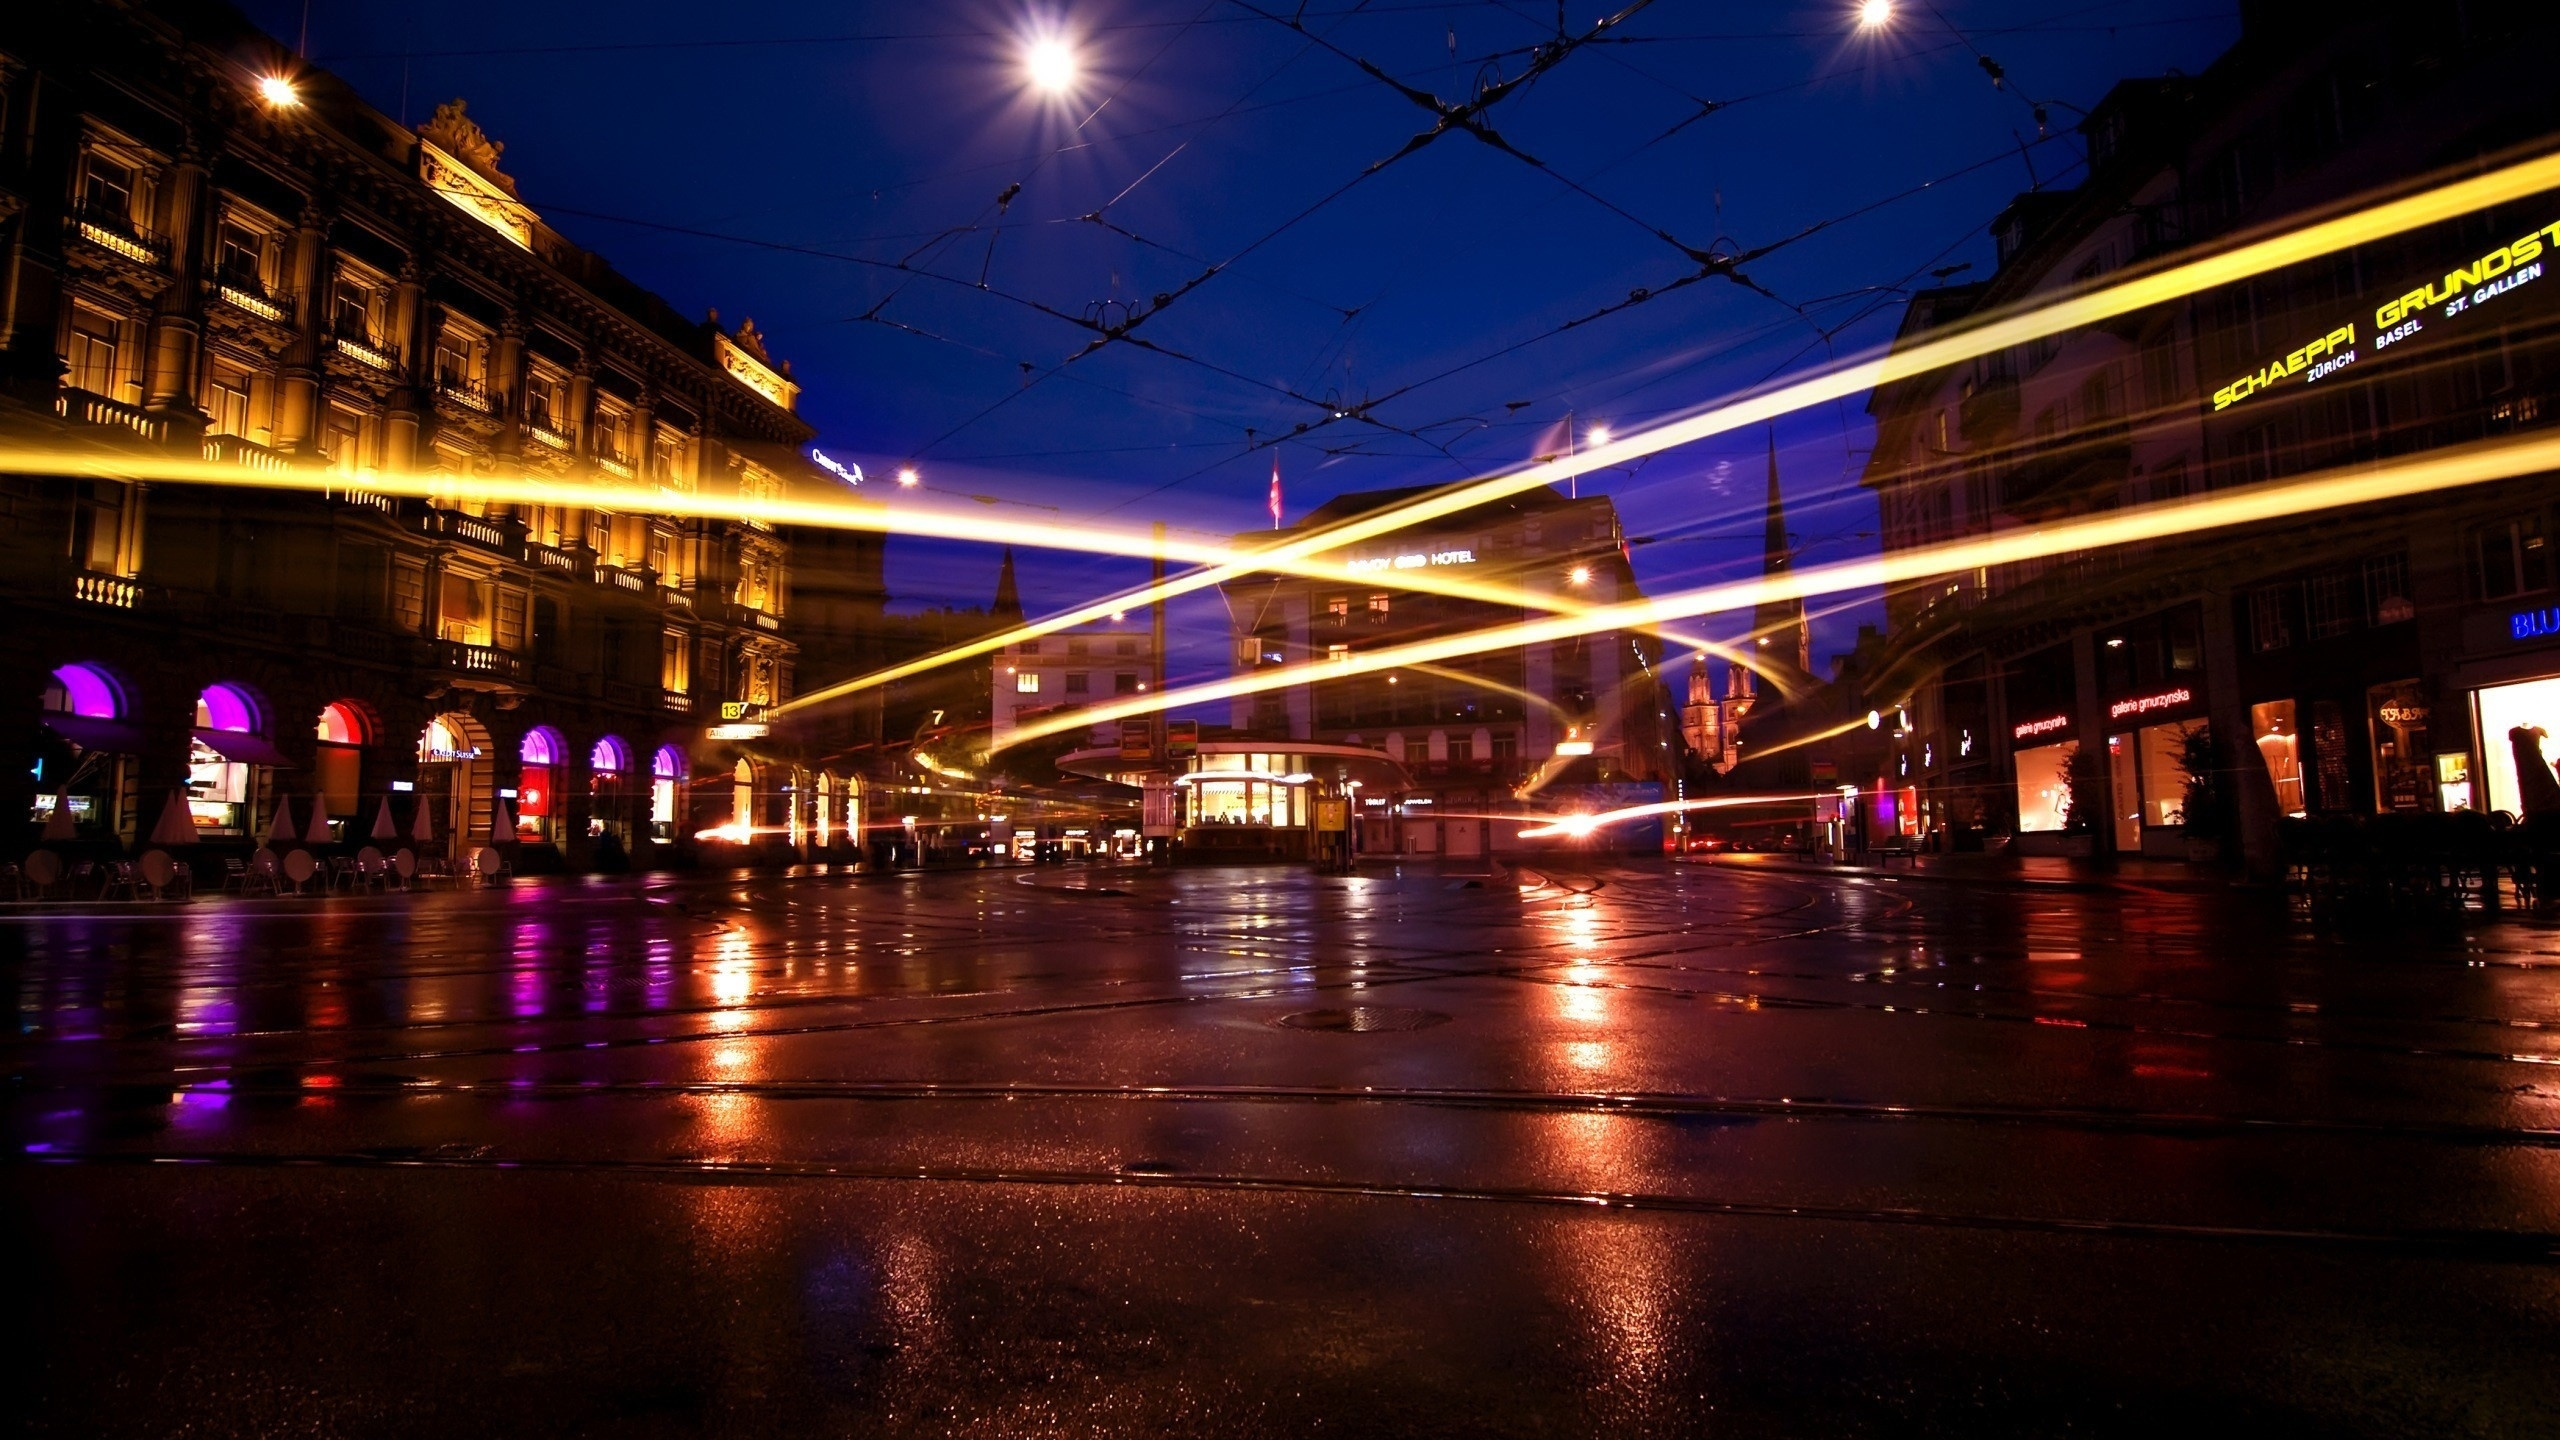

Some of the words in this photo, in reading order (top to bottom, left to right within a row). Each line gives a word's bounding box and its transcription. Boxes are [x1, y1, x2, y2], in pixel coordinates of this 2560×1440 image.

[2307, 350, 2355, 383] ZÜRICH
[2376, 319, 2423, 350] BASEL
[2446, 296, 2469, 318] ST.
[2473, 262, 2542, 305] GALLEN
[2213, 323, 2355, 411] SCHAEPPI
[1432, 550, 1476, 565] HOTEL
[739, 701, 749, 714] 7
[2111, 699, 2138, 717] galerie
[2139, 689, 2190, 712] gmurzynska
[723, 705, 739, 718] 13
[932, 710, 944, 725] 7
[1569, 727, 1578, 738] 2
